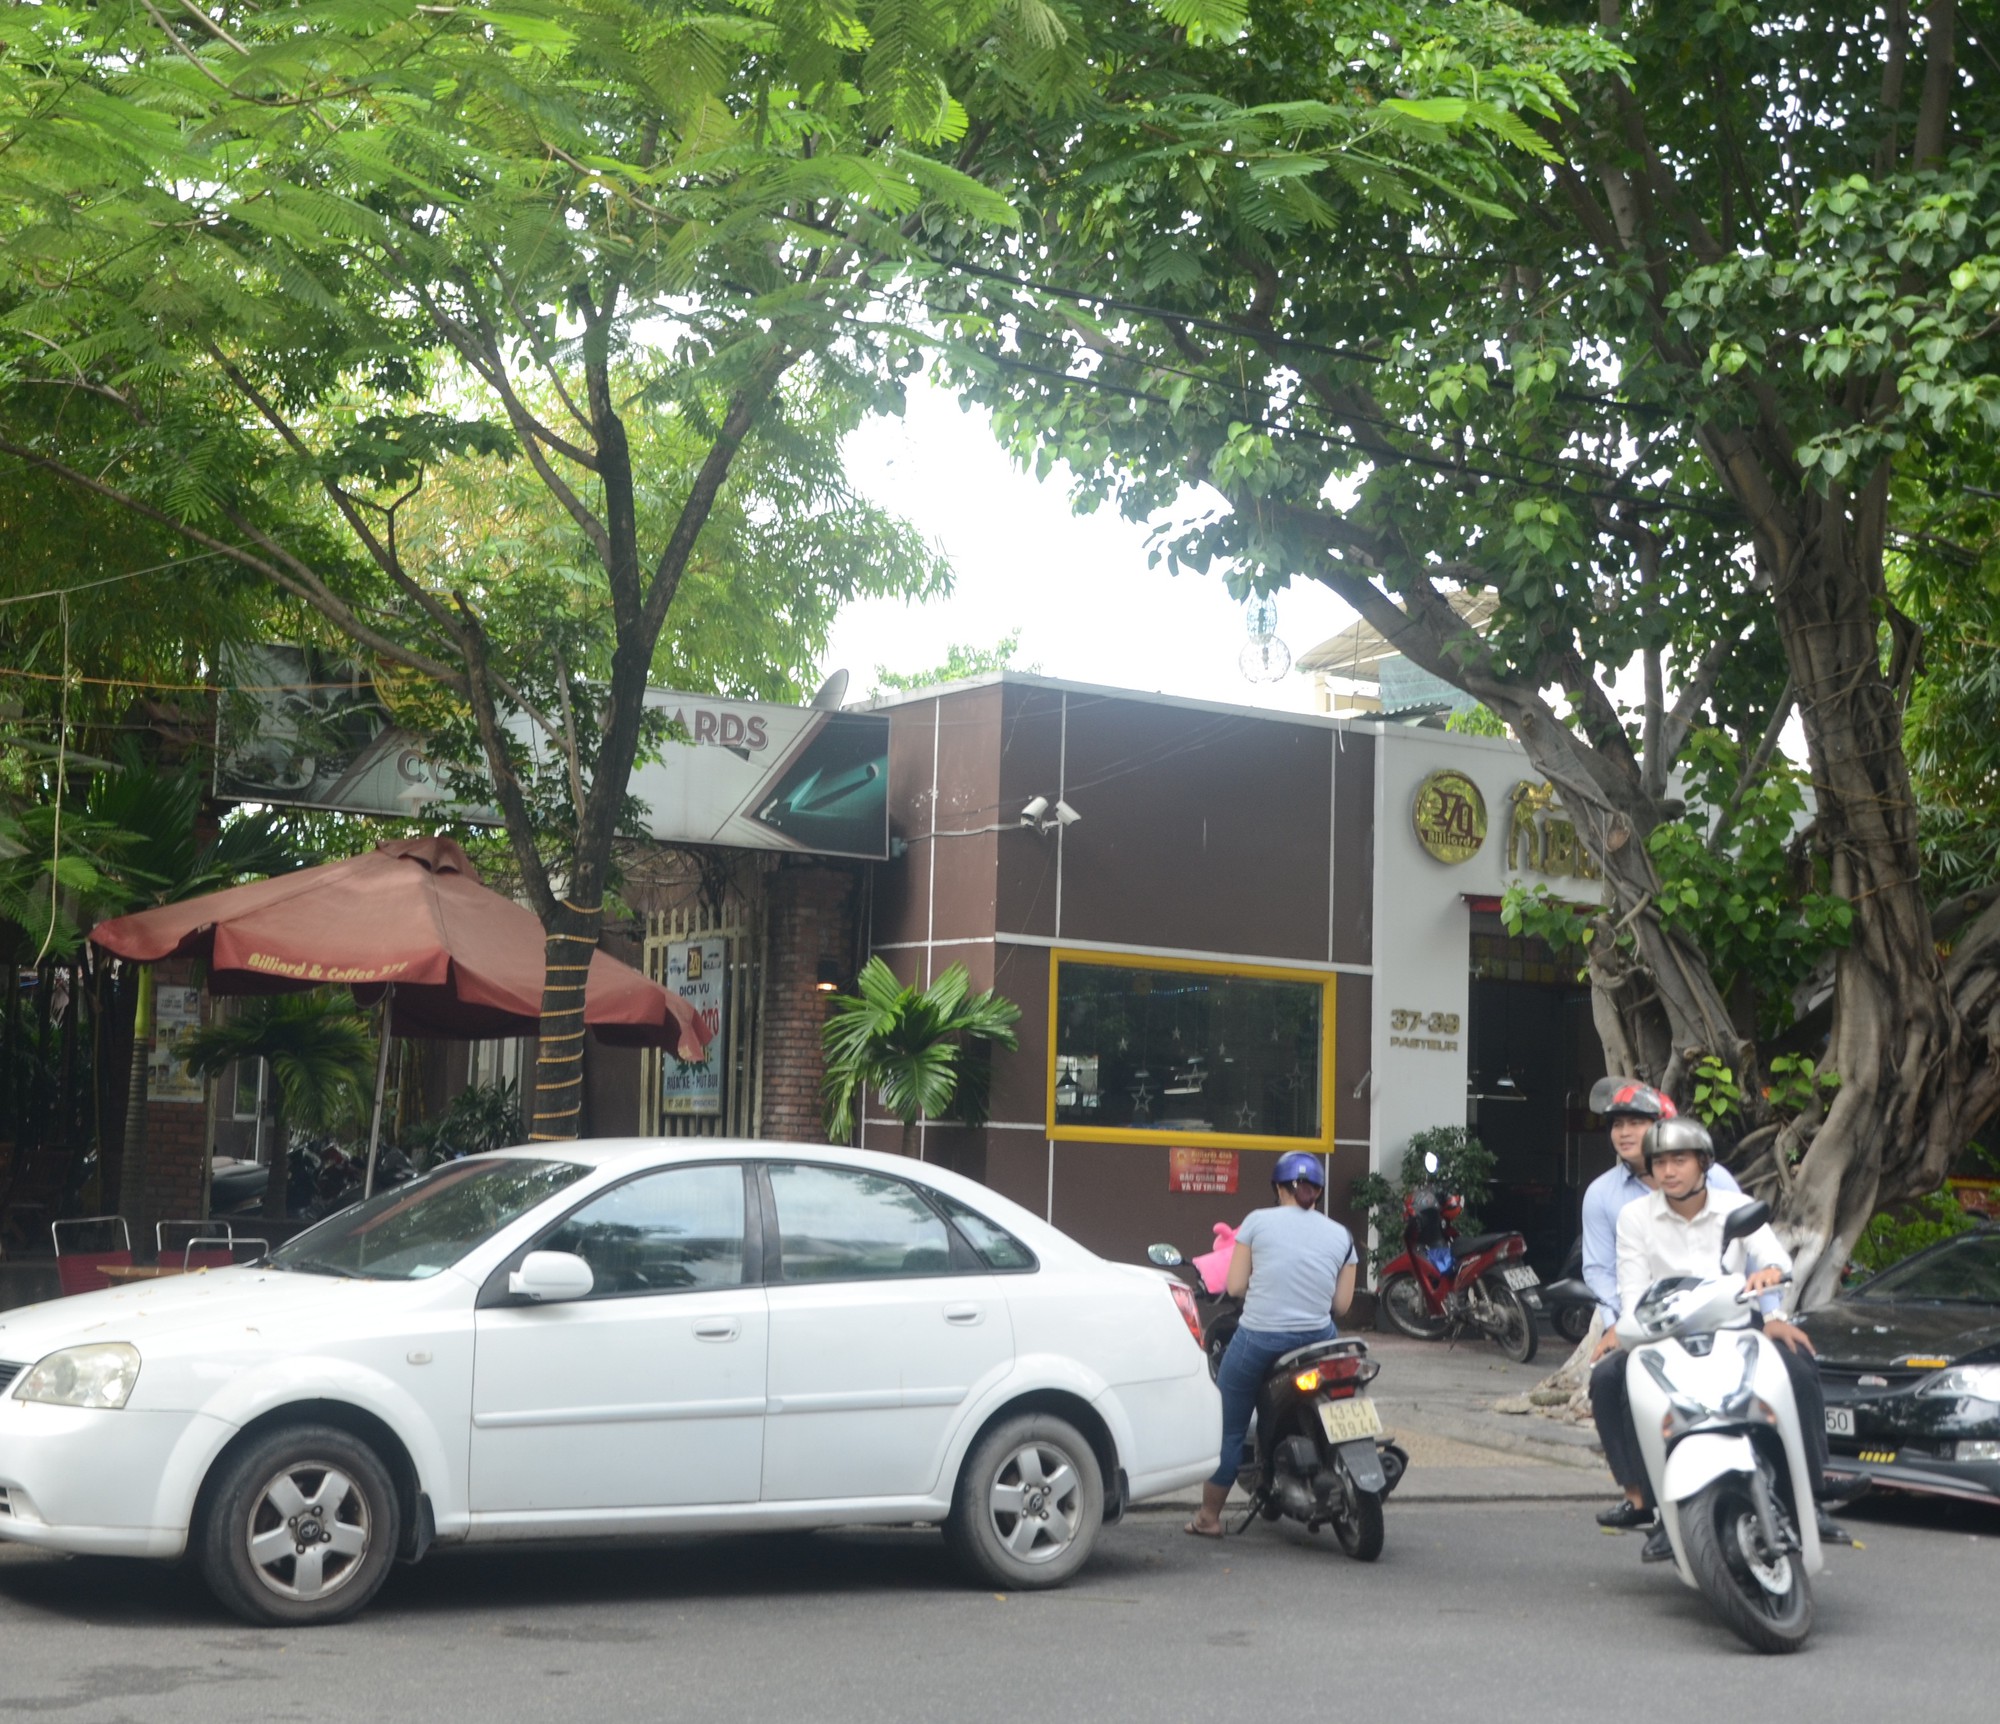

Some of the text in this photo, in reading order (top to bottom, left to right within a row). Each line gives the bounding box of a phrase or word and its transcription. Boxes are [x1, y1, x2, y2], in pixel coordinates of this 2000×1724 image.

[658, 706, 769, 751] ARDS
[248, 952, 307, 977] Billiard
[308, 964, 323, 979] &
[327, 967, 376, 980] Coffee
[1390, 1036, 1459, 1052] PASTEUR
